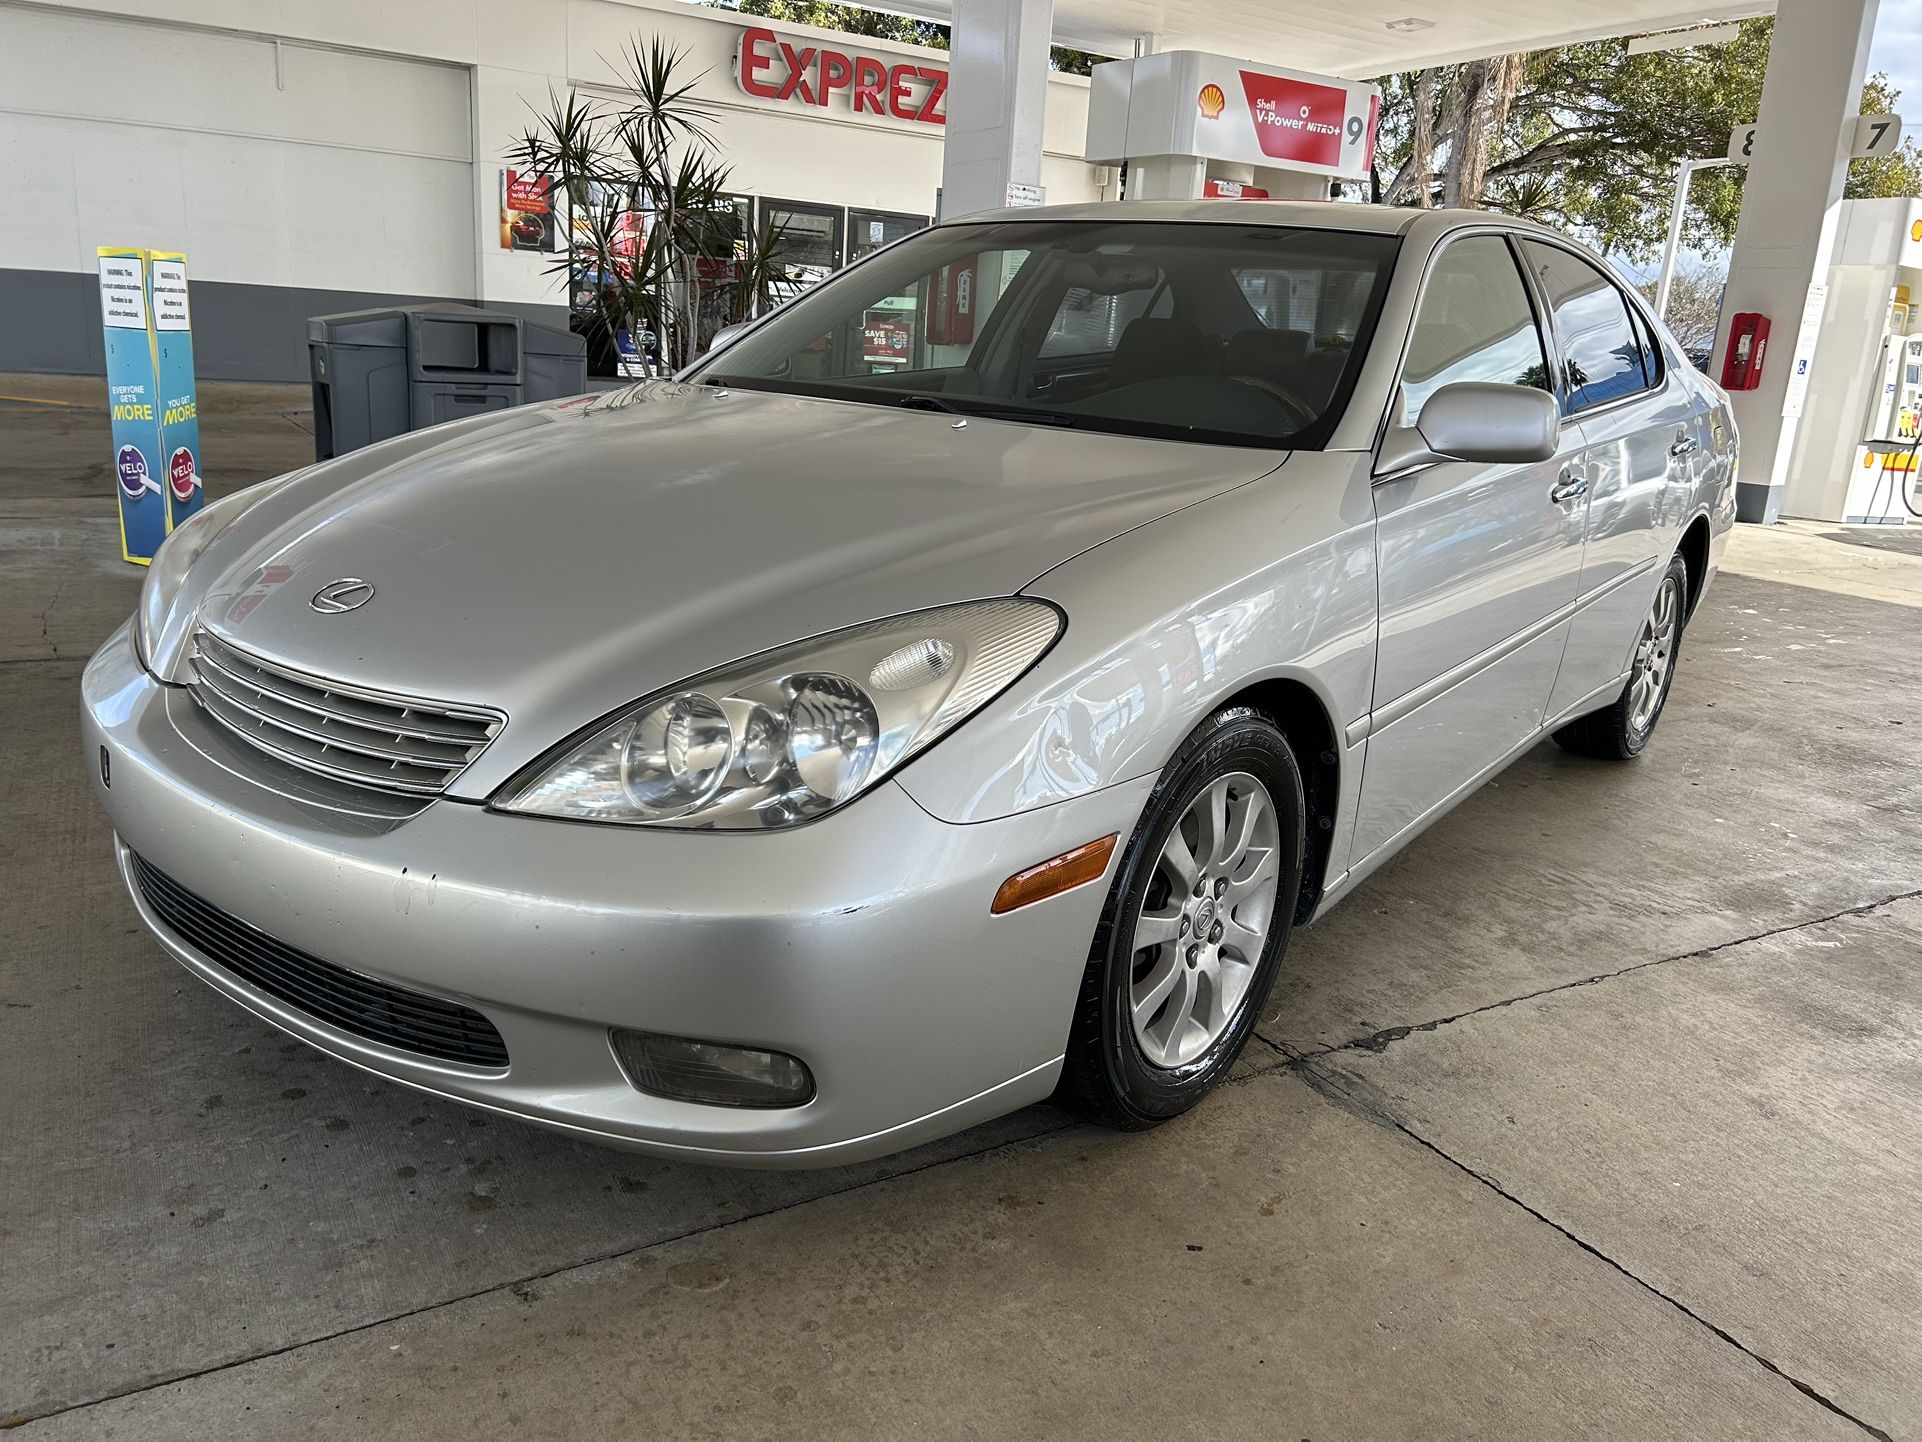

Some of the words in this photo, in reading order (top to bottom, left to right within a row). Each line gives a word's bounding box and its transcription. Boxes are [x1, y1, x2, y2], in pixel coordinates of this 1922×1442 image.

[738, 26, 948, 124] EXPREZ
[1256, 98, 1276, 111] Shell
[1256, 109, 1304, 130] V-Power
[1346, 116, 1364, 146] 9
[1866, 122, 1891, 150] 7
[511, 183, 525, 191] Get
[511, 191, 527, 199] with
[864, 329, 886, 338] SAVE
[873, 337, 886, 345] $15
[112, 385, 145, 395] EVERYONE
[120, 394, 137, 403] GETS
[167, 399, 180, 408] YOU
[181, 395, 191, 405] GET
[113, 404, 153, 420] MORE
[163, 403, 197, 426] MORE
[119, 462, 145, 474] VELO
[172, 461, 193, 479] VELO
